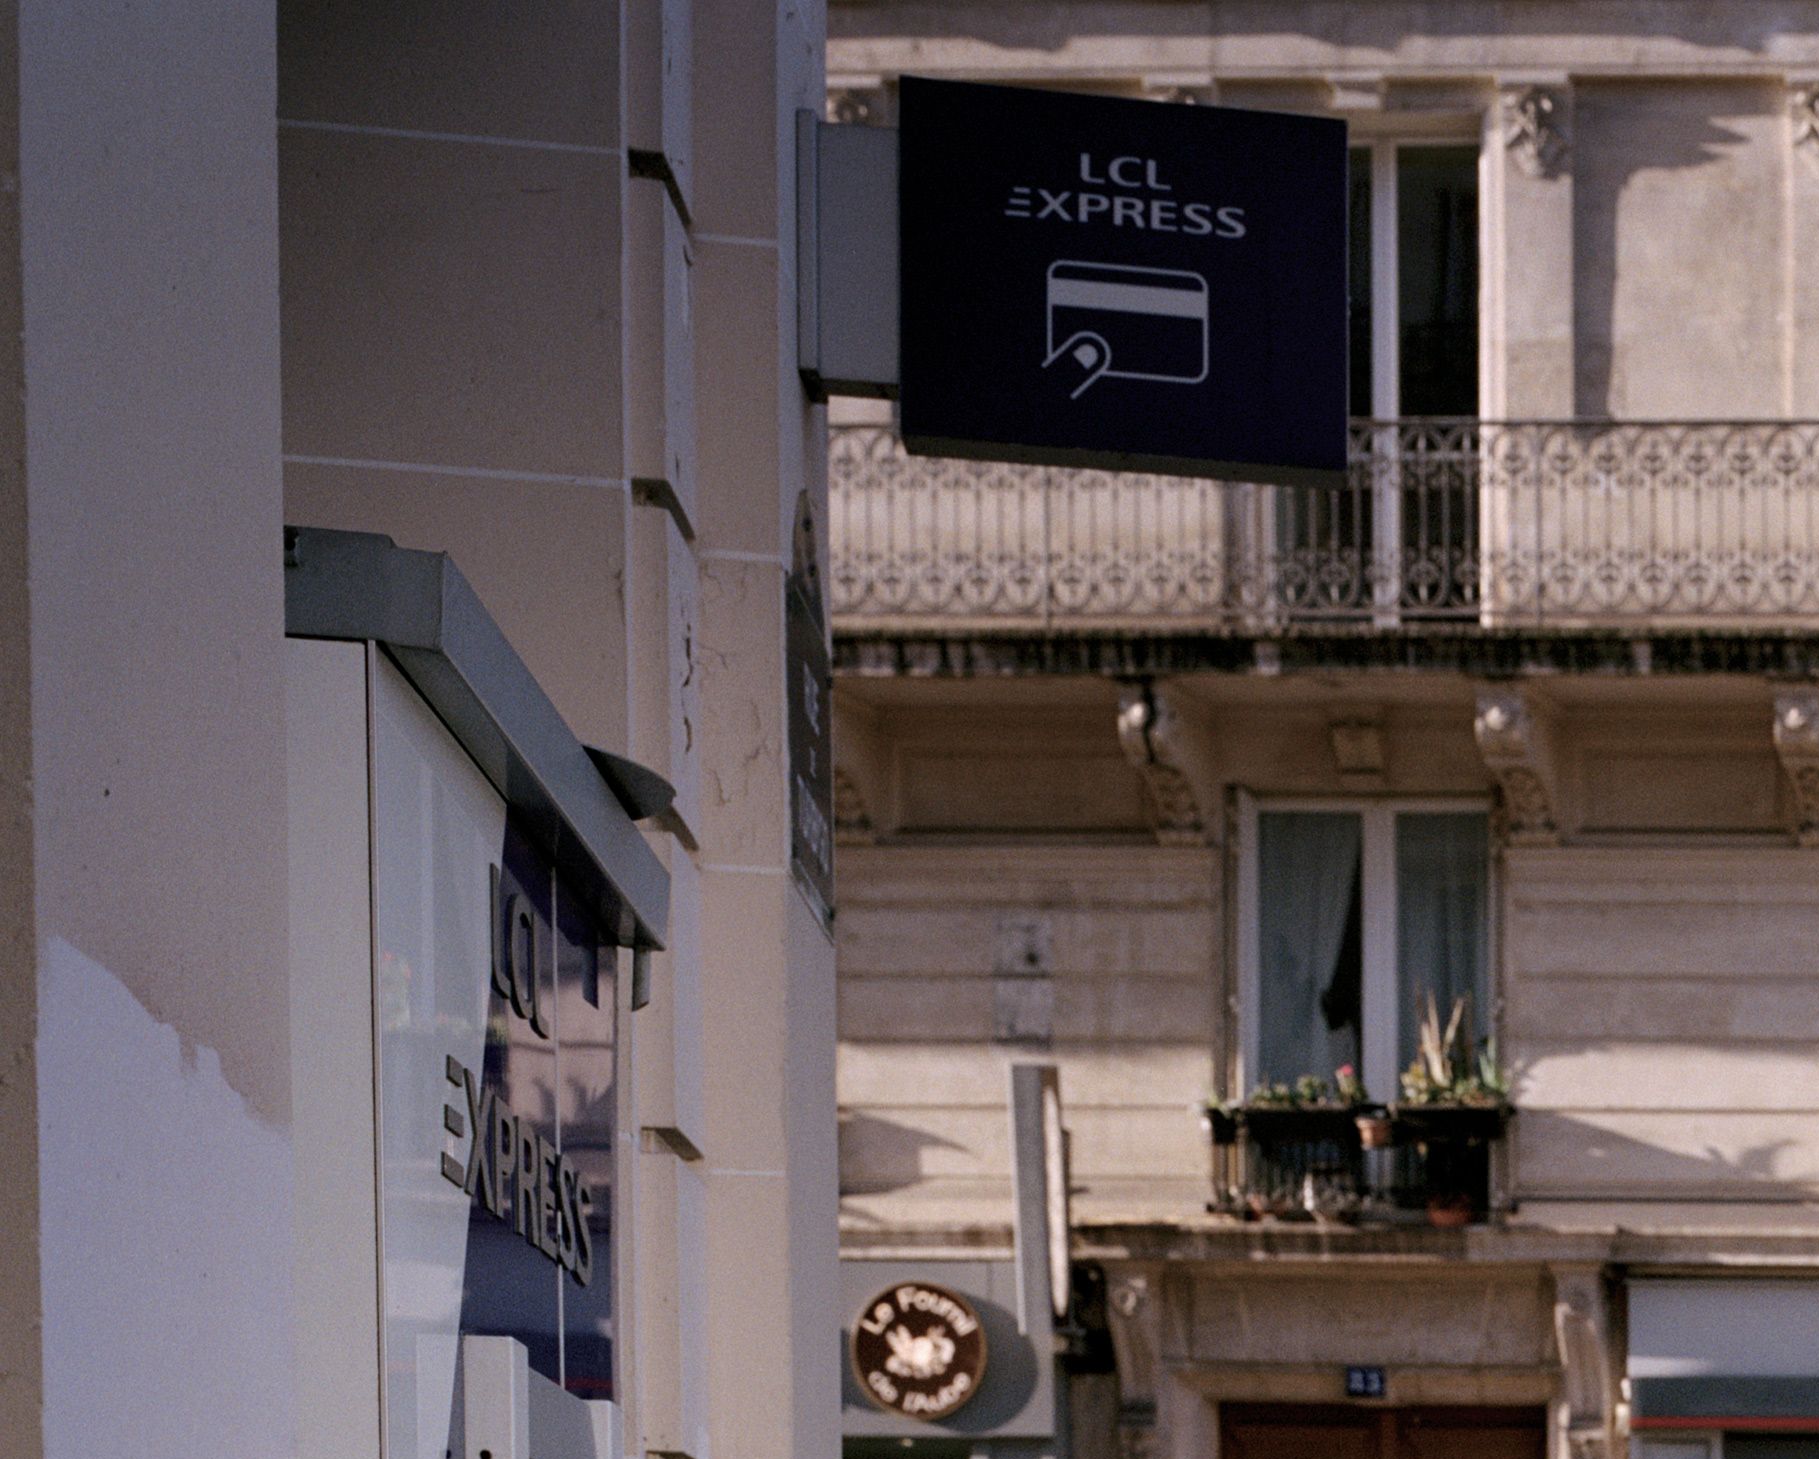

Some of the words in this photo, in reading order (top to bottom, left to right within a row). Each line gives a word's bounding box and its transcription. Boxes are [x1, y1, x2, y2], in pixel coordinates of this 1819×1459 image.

[1004, 186, 1247, 239] EXPRESS
[1080, 153, 1171, 190] LCL
[490, 862, 549, 1040] LCL
[441, 1054, 593, 1287] EXPRESS
